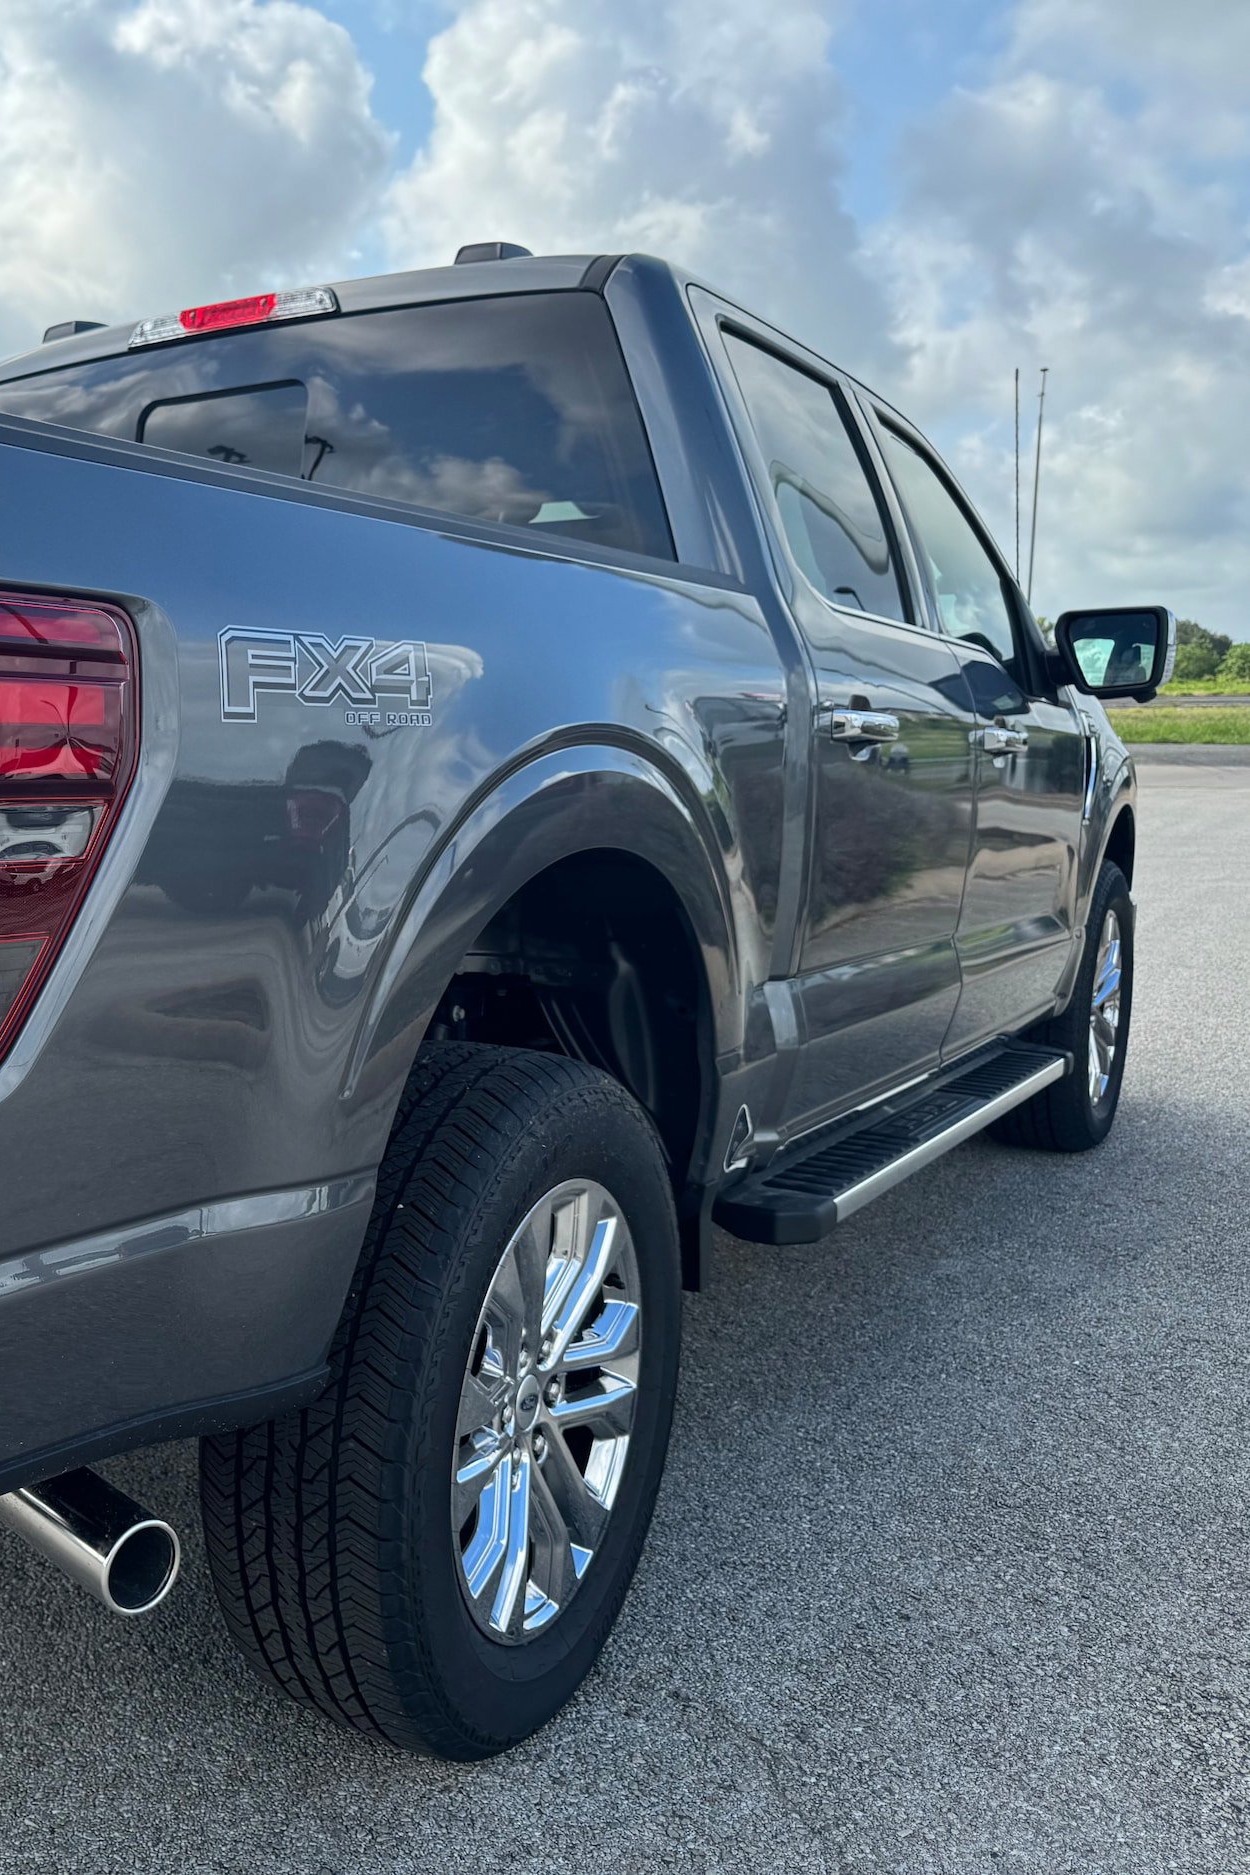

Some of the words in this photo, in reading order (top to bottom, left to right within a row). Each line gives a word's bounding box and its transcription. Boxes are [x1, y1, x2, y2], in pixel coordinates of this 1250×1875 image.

[217, 624, 433, 723] FX4
[345, 711, 380, 725] OFF
[386, 712, 432, 726] ROAD
